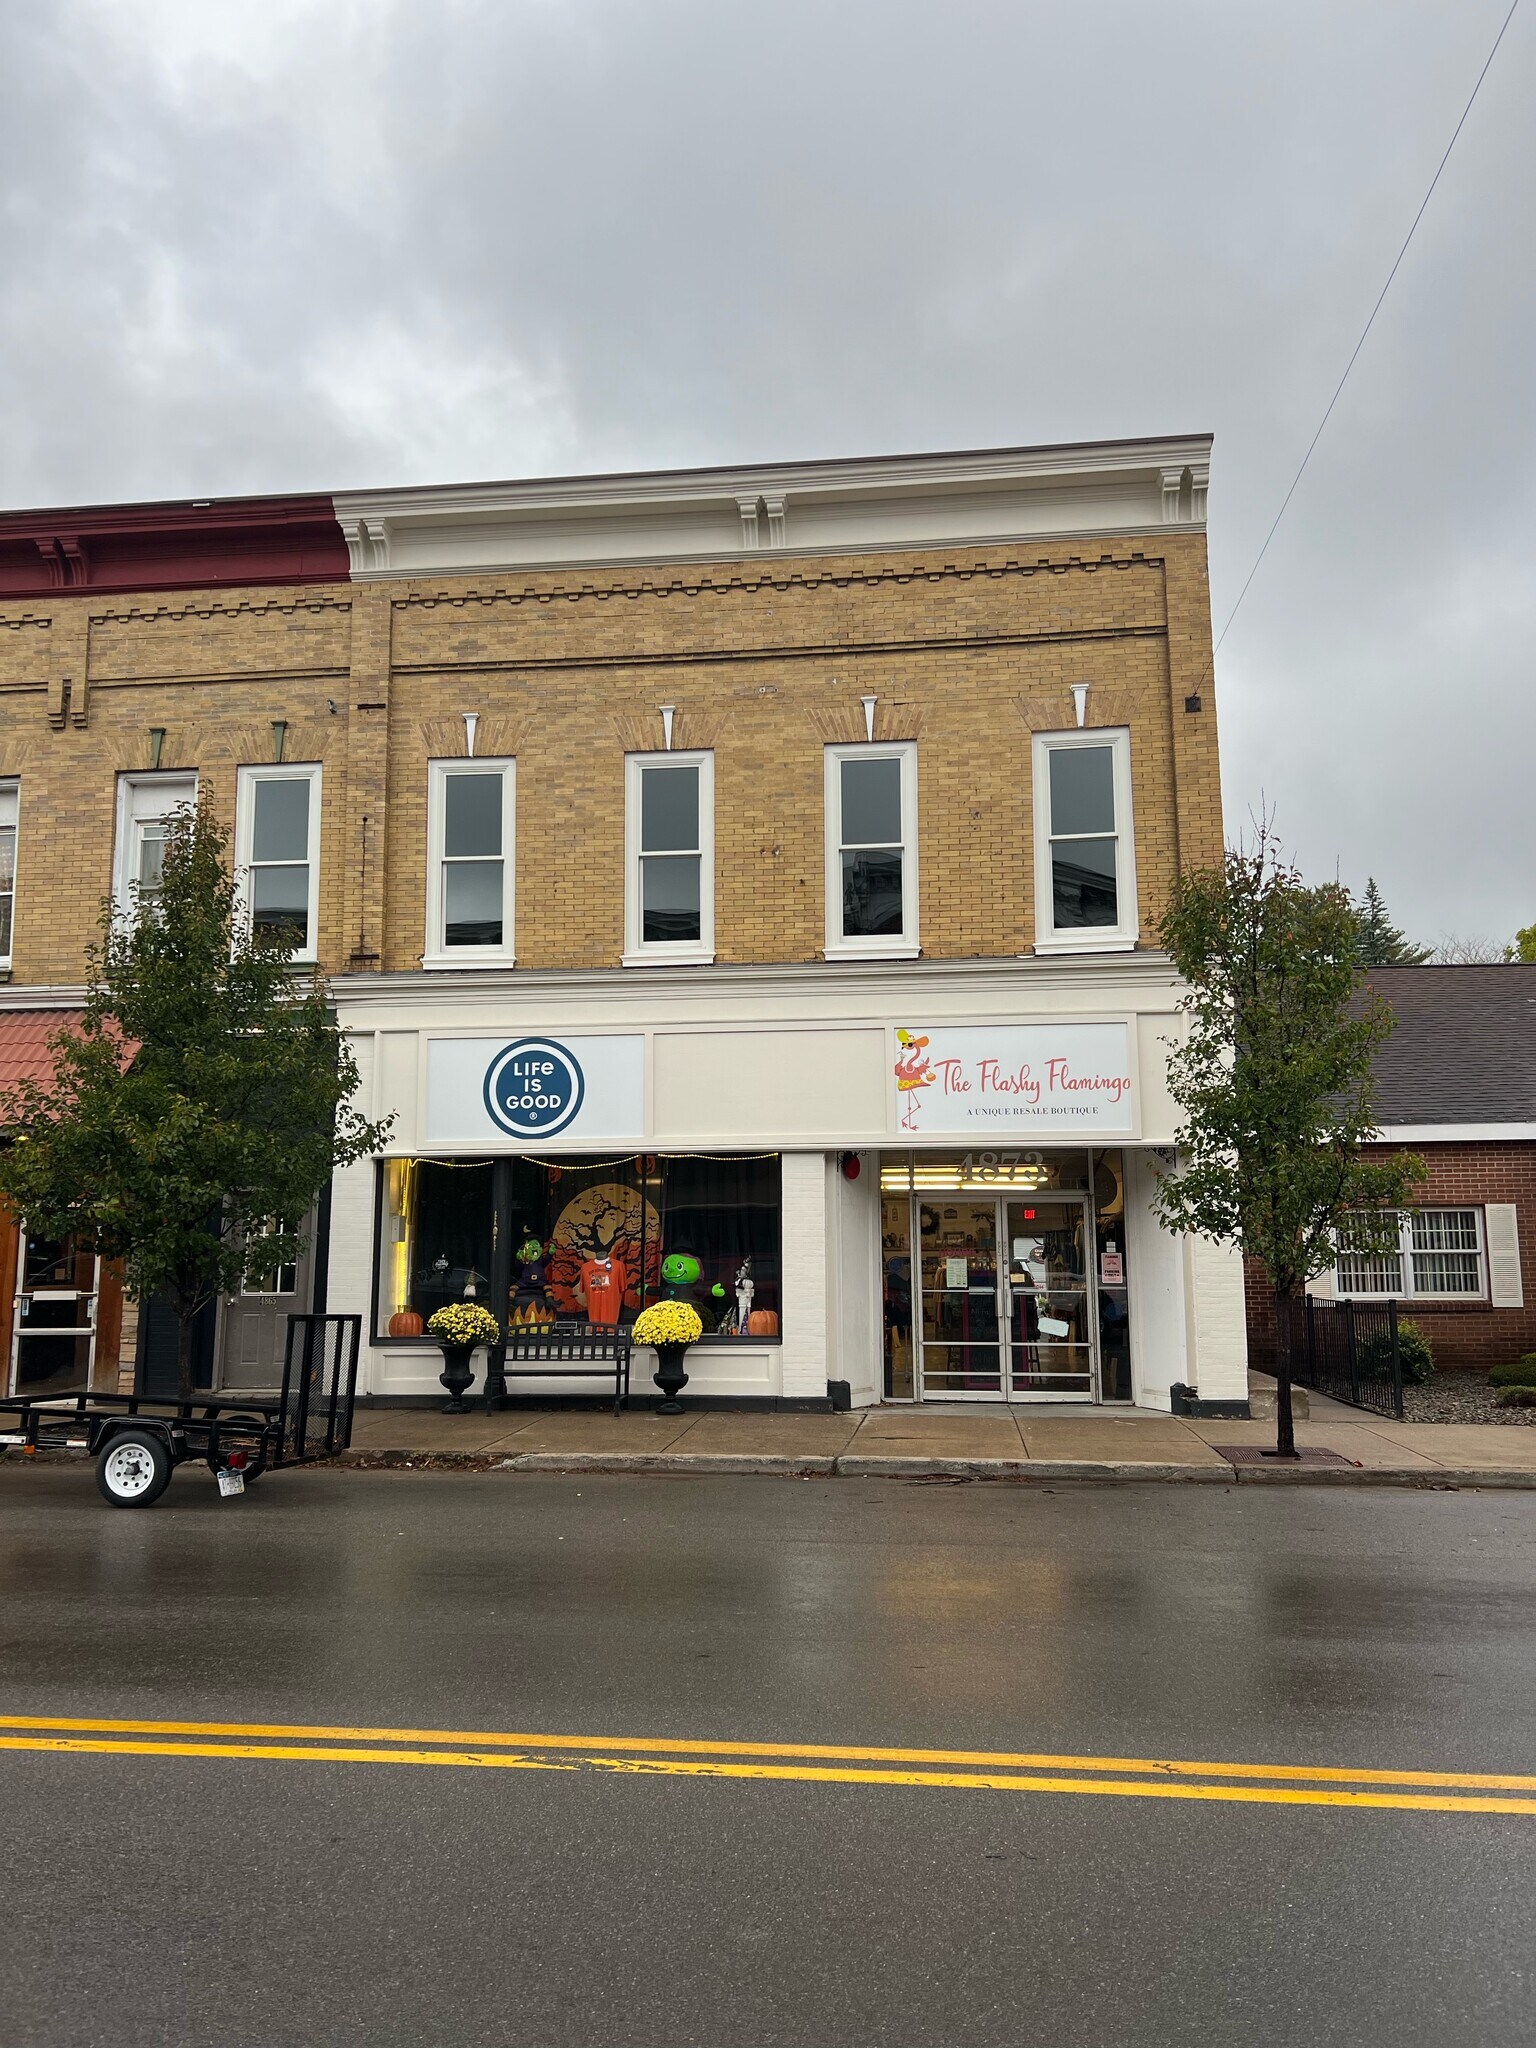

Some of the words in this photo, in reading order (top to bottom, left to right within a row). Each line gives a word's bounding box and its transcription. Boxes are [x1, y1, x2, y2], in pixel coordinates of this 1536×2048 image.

[524, 1078, 542, 1092] IS
[934, 1058, 972, 1095] The
[976, 1058, 1040, 1103] Flashy
[1044, 1057, 1131, 1102] Flamingo
[506, 1094, 562, 1109] GOOD
[975, 1108, 1010, 1117] UNIQUE
[1013, 1107, 1049, 1115] RESALE
[1050, 1106, 1099, 1115] BOUTIQUE
[956, 1151, 1045, 1182] 4873
[1024, 1209, 1036, 1219] EXIT
[260, 1297, 277, 1305] 4865
